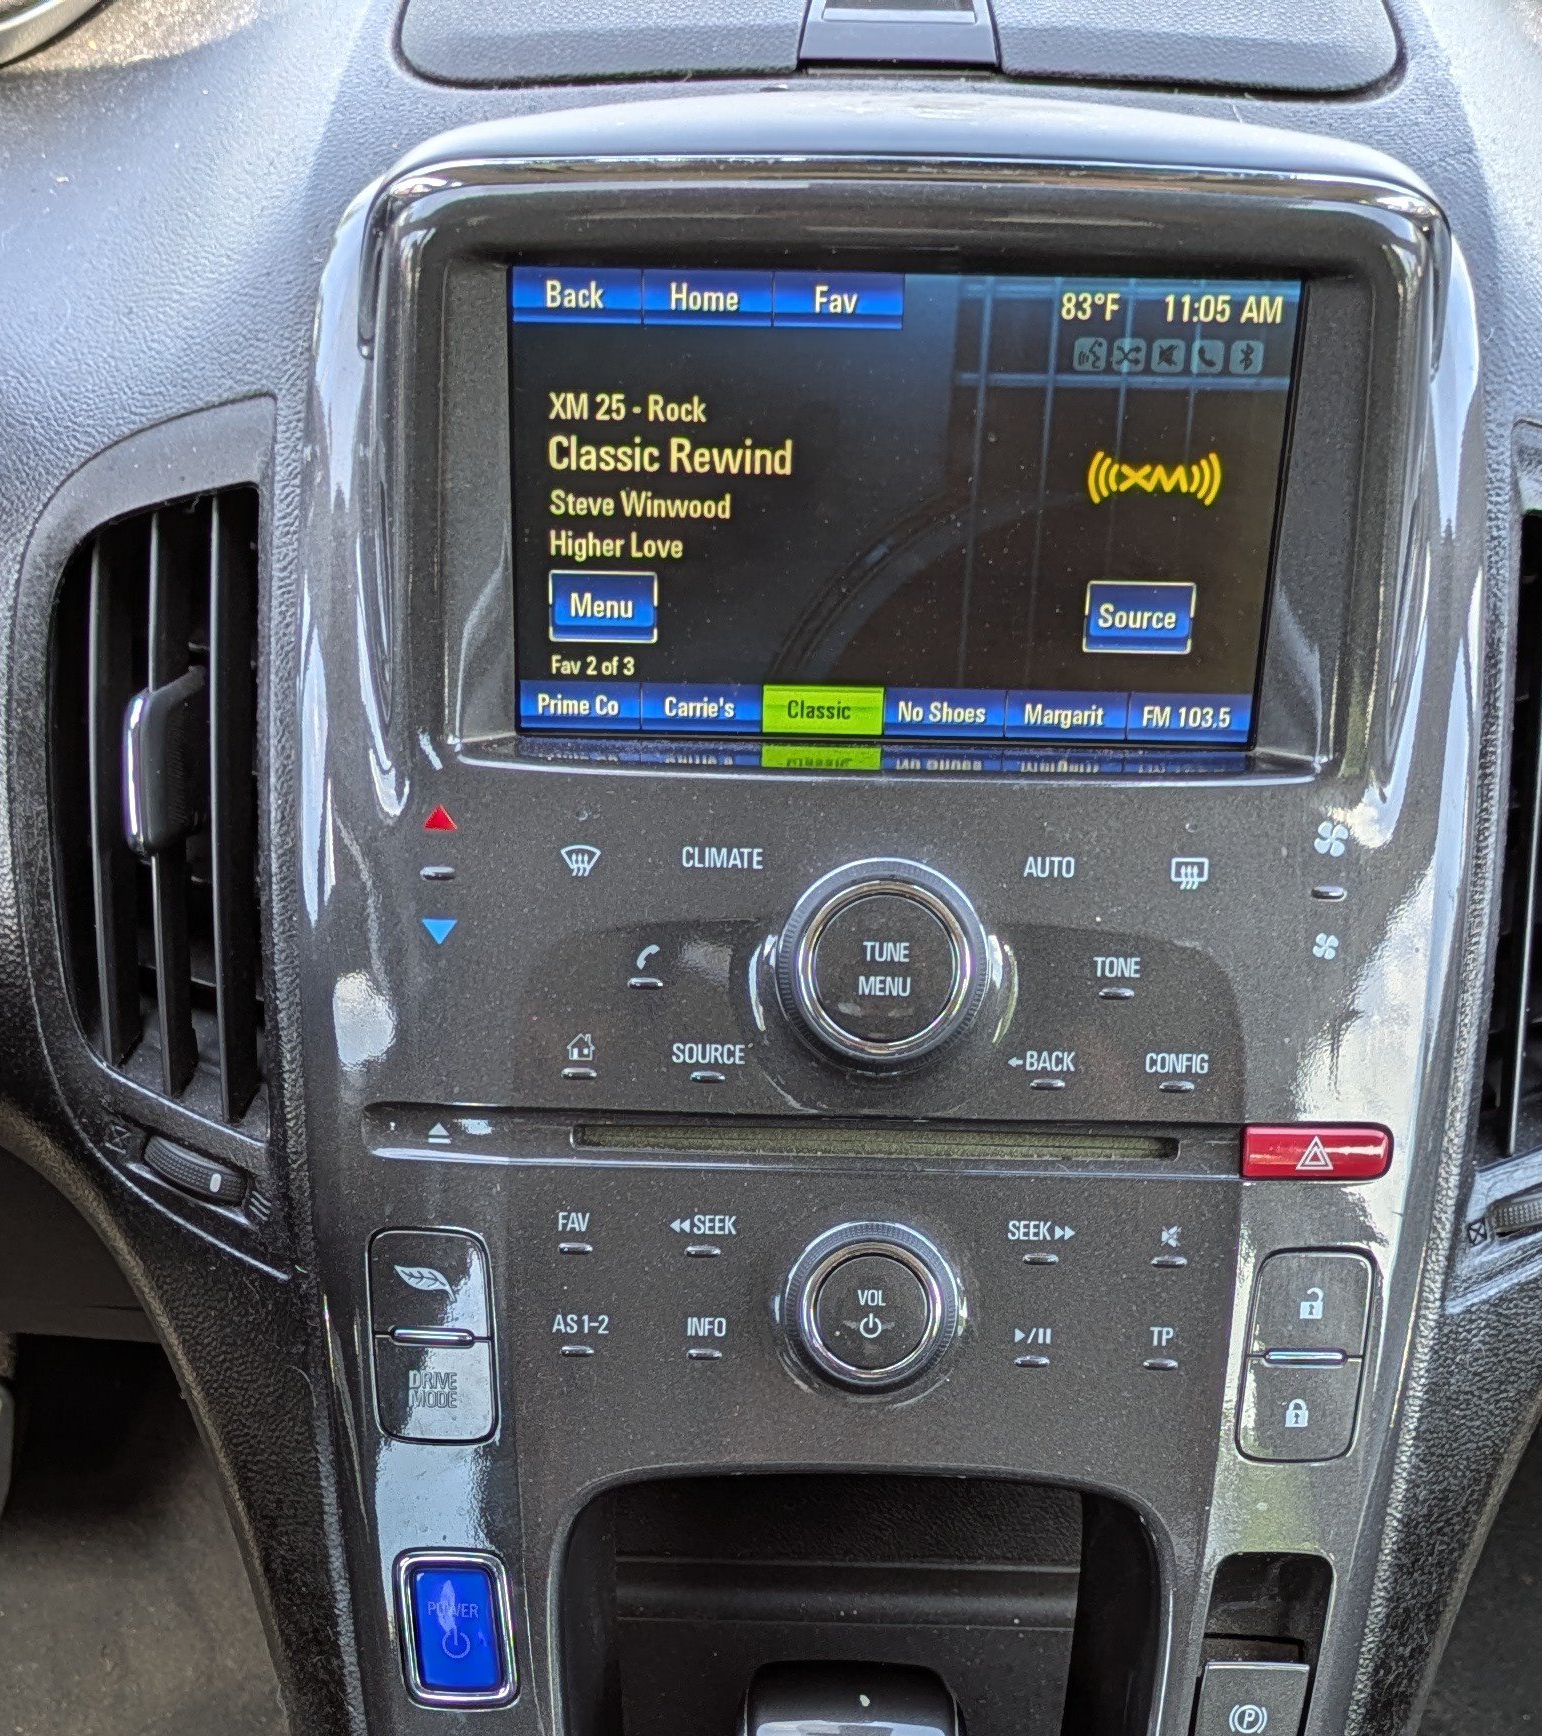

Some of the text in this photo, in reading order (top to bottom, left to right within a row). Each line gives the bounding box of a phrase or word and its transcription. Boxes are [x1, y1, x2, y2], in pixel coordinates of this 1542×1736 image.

[544, 279, 604, 309] Back
[670, 282, 739, 312] Home
[814, 285, 858, 314] Fav
[1061, 292, 1121, 322] 83°F
[1165, 294, 1283, 324] 11:05 AM
[548, 392, 588, 420] XM
[595, 393, 626, 421] 25
[648, 394, 707, 422] Rock
[548, 434, 793, 476] Classic Rewind
[549, 488, 731, 519] Steve Winwood
[549, 529, 683, 562] Higher Love
[570, 592, 633, 619] Menu
[1098, 602, 1176, 629] Source
[551, 654, 635, 676] Fav 2 of 3
[537, 694, 619, 716] Prime Co
[664, 696, 735, 719] Carrie's
[787, 699, 851, 721] Classic
[897, 701, 986, 724] No Shoes
[1024, 704, 1104, 729] Margarit
[1142, 706, 1170, 727] FM
[681, 846, 764, 870] CLIMATE
[1023, 856, 1075, 879] AUTO
[862, 941, 910, 963] TUNE
[1093, 956, 1141, 978] TONE
[858, 975, 911, 997] MENU
[671, 1042, 745, 1065] SOURCE
[1025, 1051, 1076, 1072] BACK
[1145, 1052, 1209, 1074] CONFIG
[557, 1211, 590, 1232] FAV
[693, 1215, 737, 1236] SEEK
[1007, 1221, 1051, 1242] SEEK
[858, 1289, 886, 1307] VOL
[686, 1317, 726, 1337] INFO
[1149, 1327, 1174, 1347] TP
[408, 1370, 457, 1390] DRIVE
[408, 1390, 457, 1408] MODE
[427, 1601, 479, 1619] POWER
